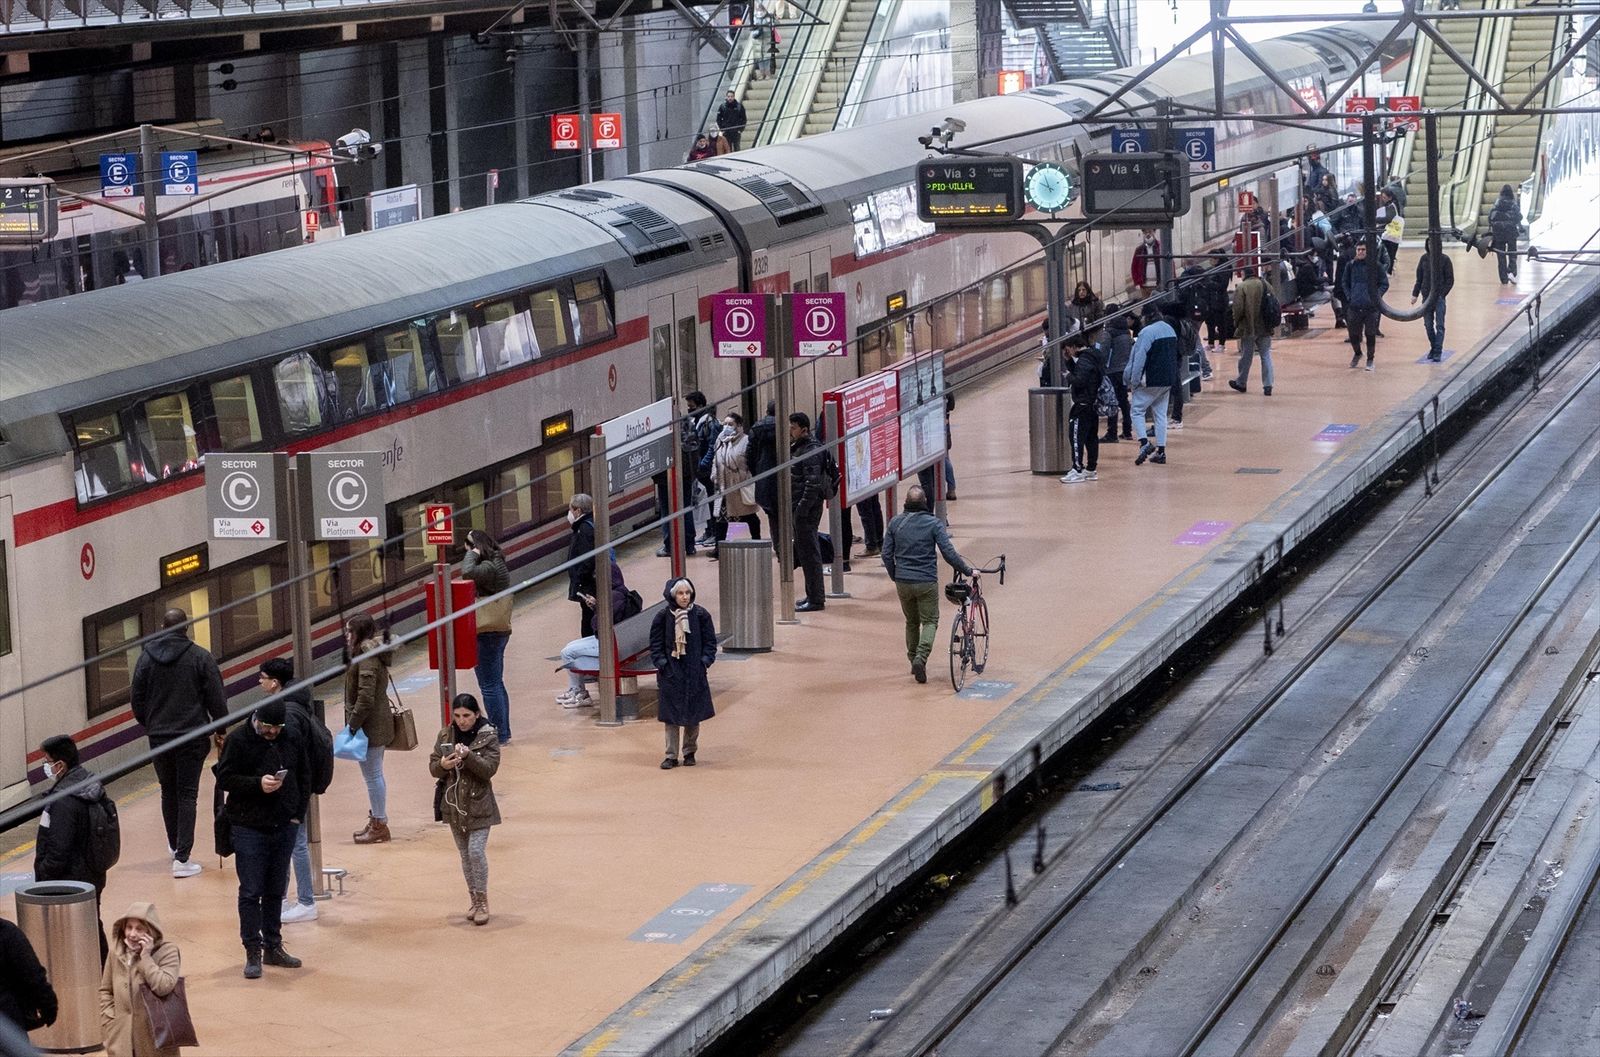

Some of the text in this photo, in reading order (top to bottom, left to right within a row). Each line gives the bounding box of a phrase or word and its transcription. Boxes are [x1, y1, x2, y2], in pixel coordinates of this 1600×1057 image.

[561, 125, 570, 137] F
[603, 124, 612, 136] F
[1190, 142, 1202, 157] E
[112, 166, 123, 181] E
[969, 163, 976, 178] 3
[1132, 163, 1140, 175] 4
[5, 188, 12, 199] 2
[732, 311, 750, 332] D
[812, 311, 830, 332] D
[624, 419, 645, 441] Atocha
[381, 438, 403, 472] enfe
[221, 460, 257, 469] SECTOR
[328, 459, 364, 468] SECTOR
[228, 477, 252, 506] C
[335, 476, 360, 505] C
[218, 527, 248, 537] Platform
[254, 522, 262, 533] 3
[326, 527, 356, 537] Platform
[361, 521, 369, 532] 4
